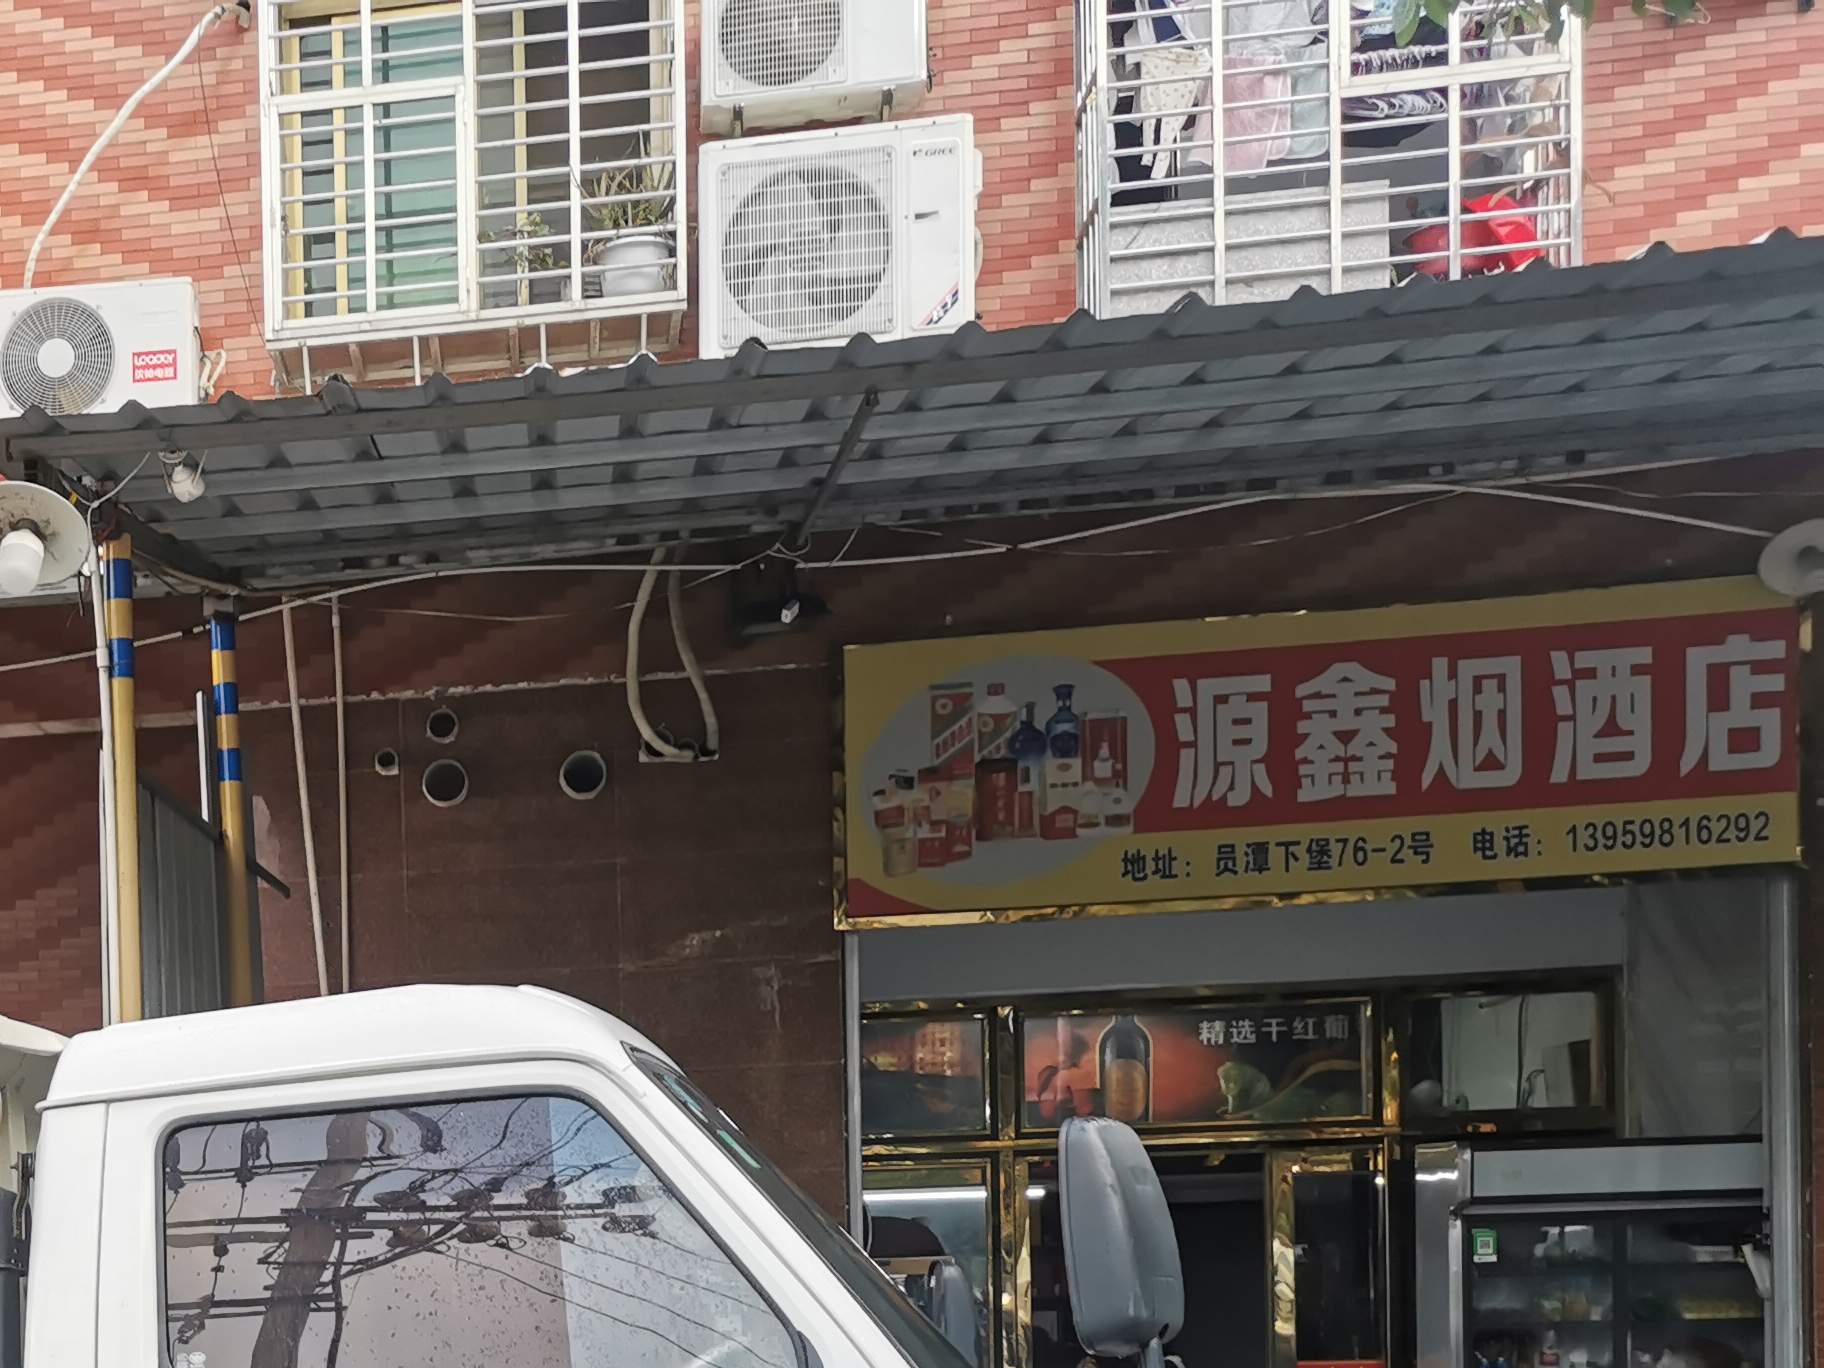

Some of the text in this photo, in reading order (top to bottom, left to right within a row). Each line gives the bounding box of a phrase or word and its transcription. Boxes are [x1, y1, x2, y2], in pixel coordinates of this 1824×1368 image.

[1172, 633, 1787, 809] 源鑫烟酒店
